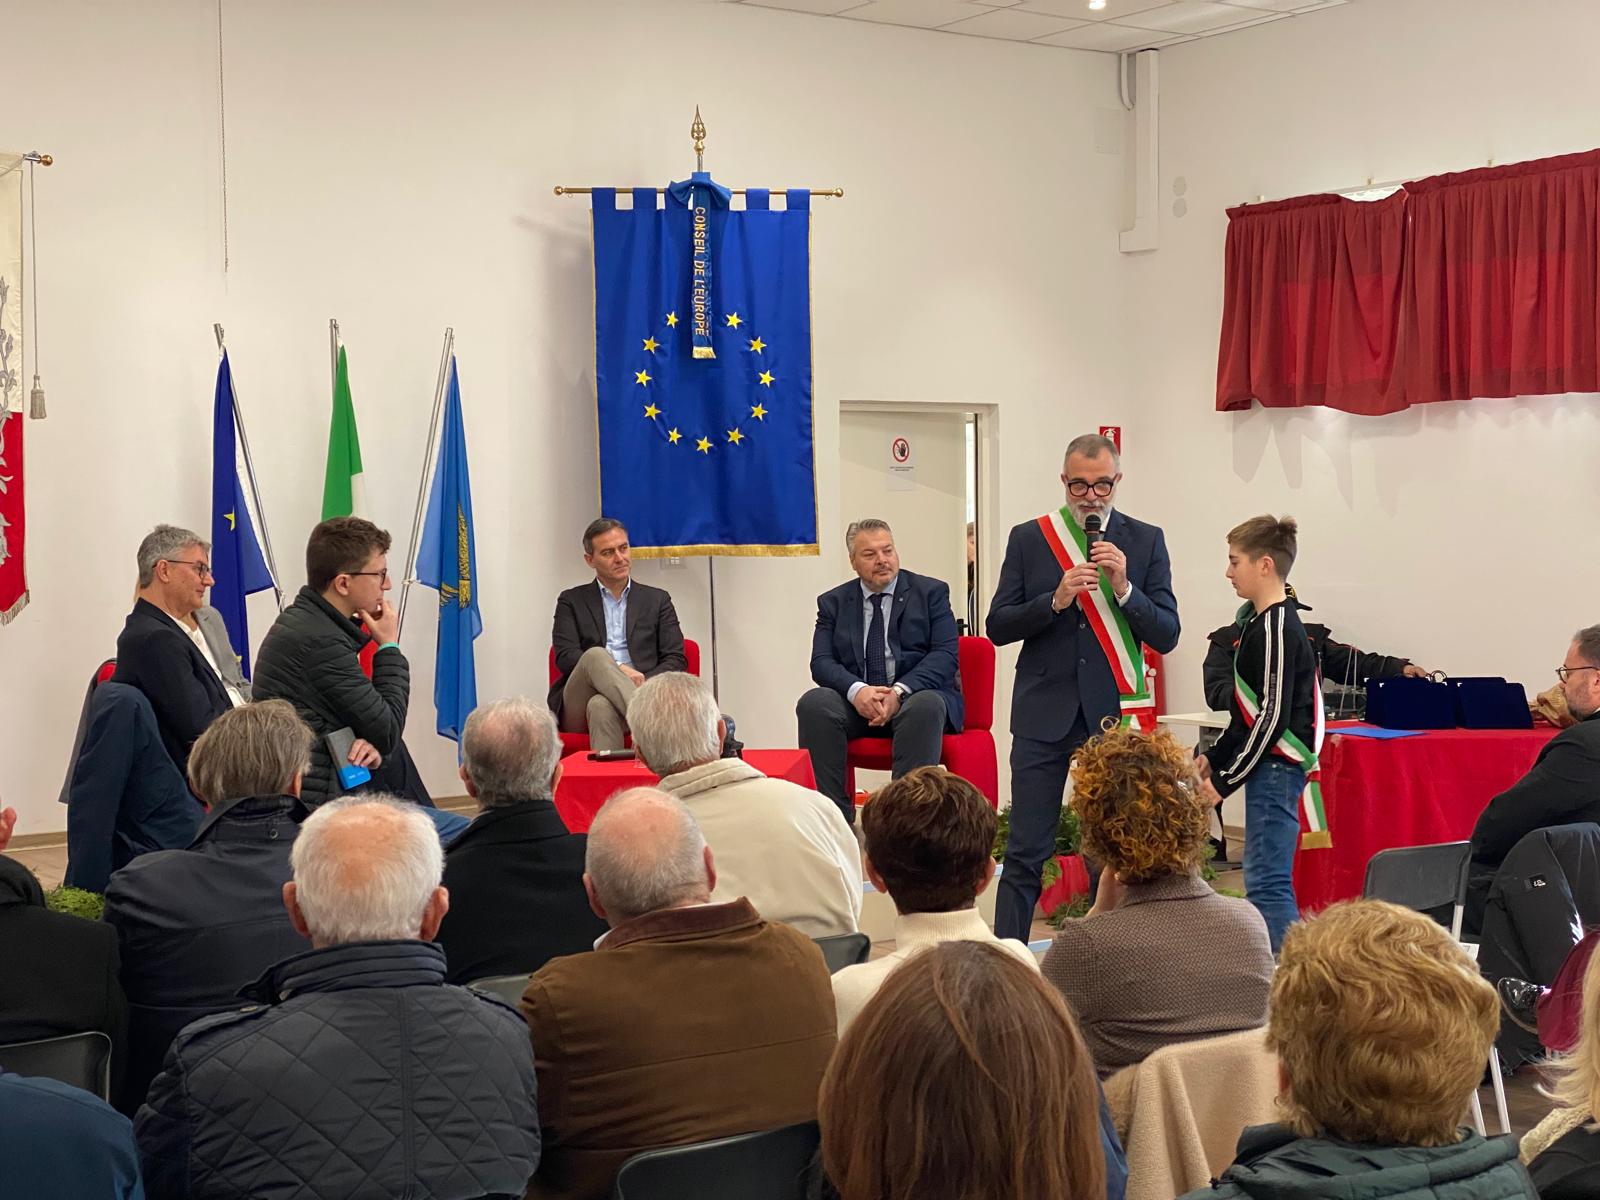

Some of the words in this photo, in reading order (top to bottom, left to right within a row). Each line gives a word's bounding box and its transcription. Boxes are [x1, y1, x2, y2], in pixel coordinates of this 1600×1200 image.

[693, 207, 706, 257] CONSEIL
[694, 260, 705, 276] DE
[693, 280, 706, 336] L'EUROPE
